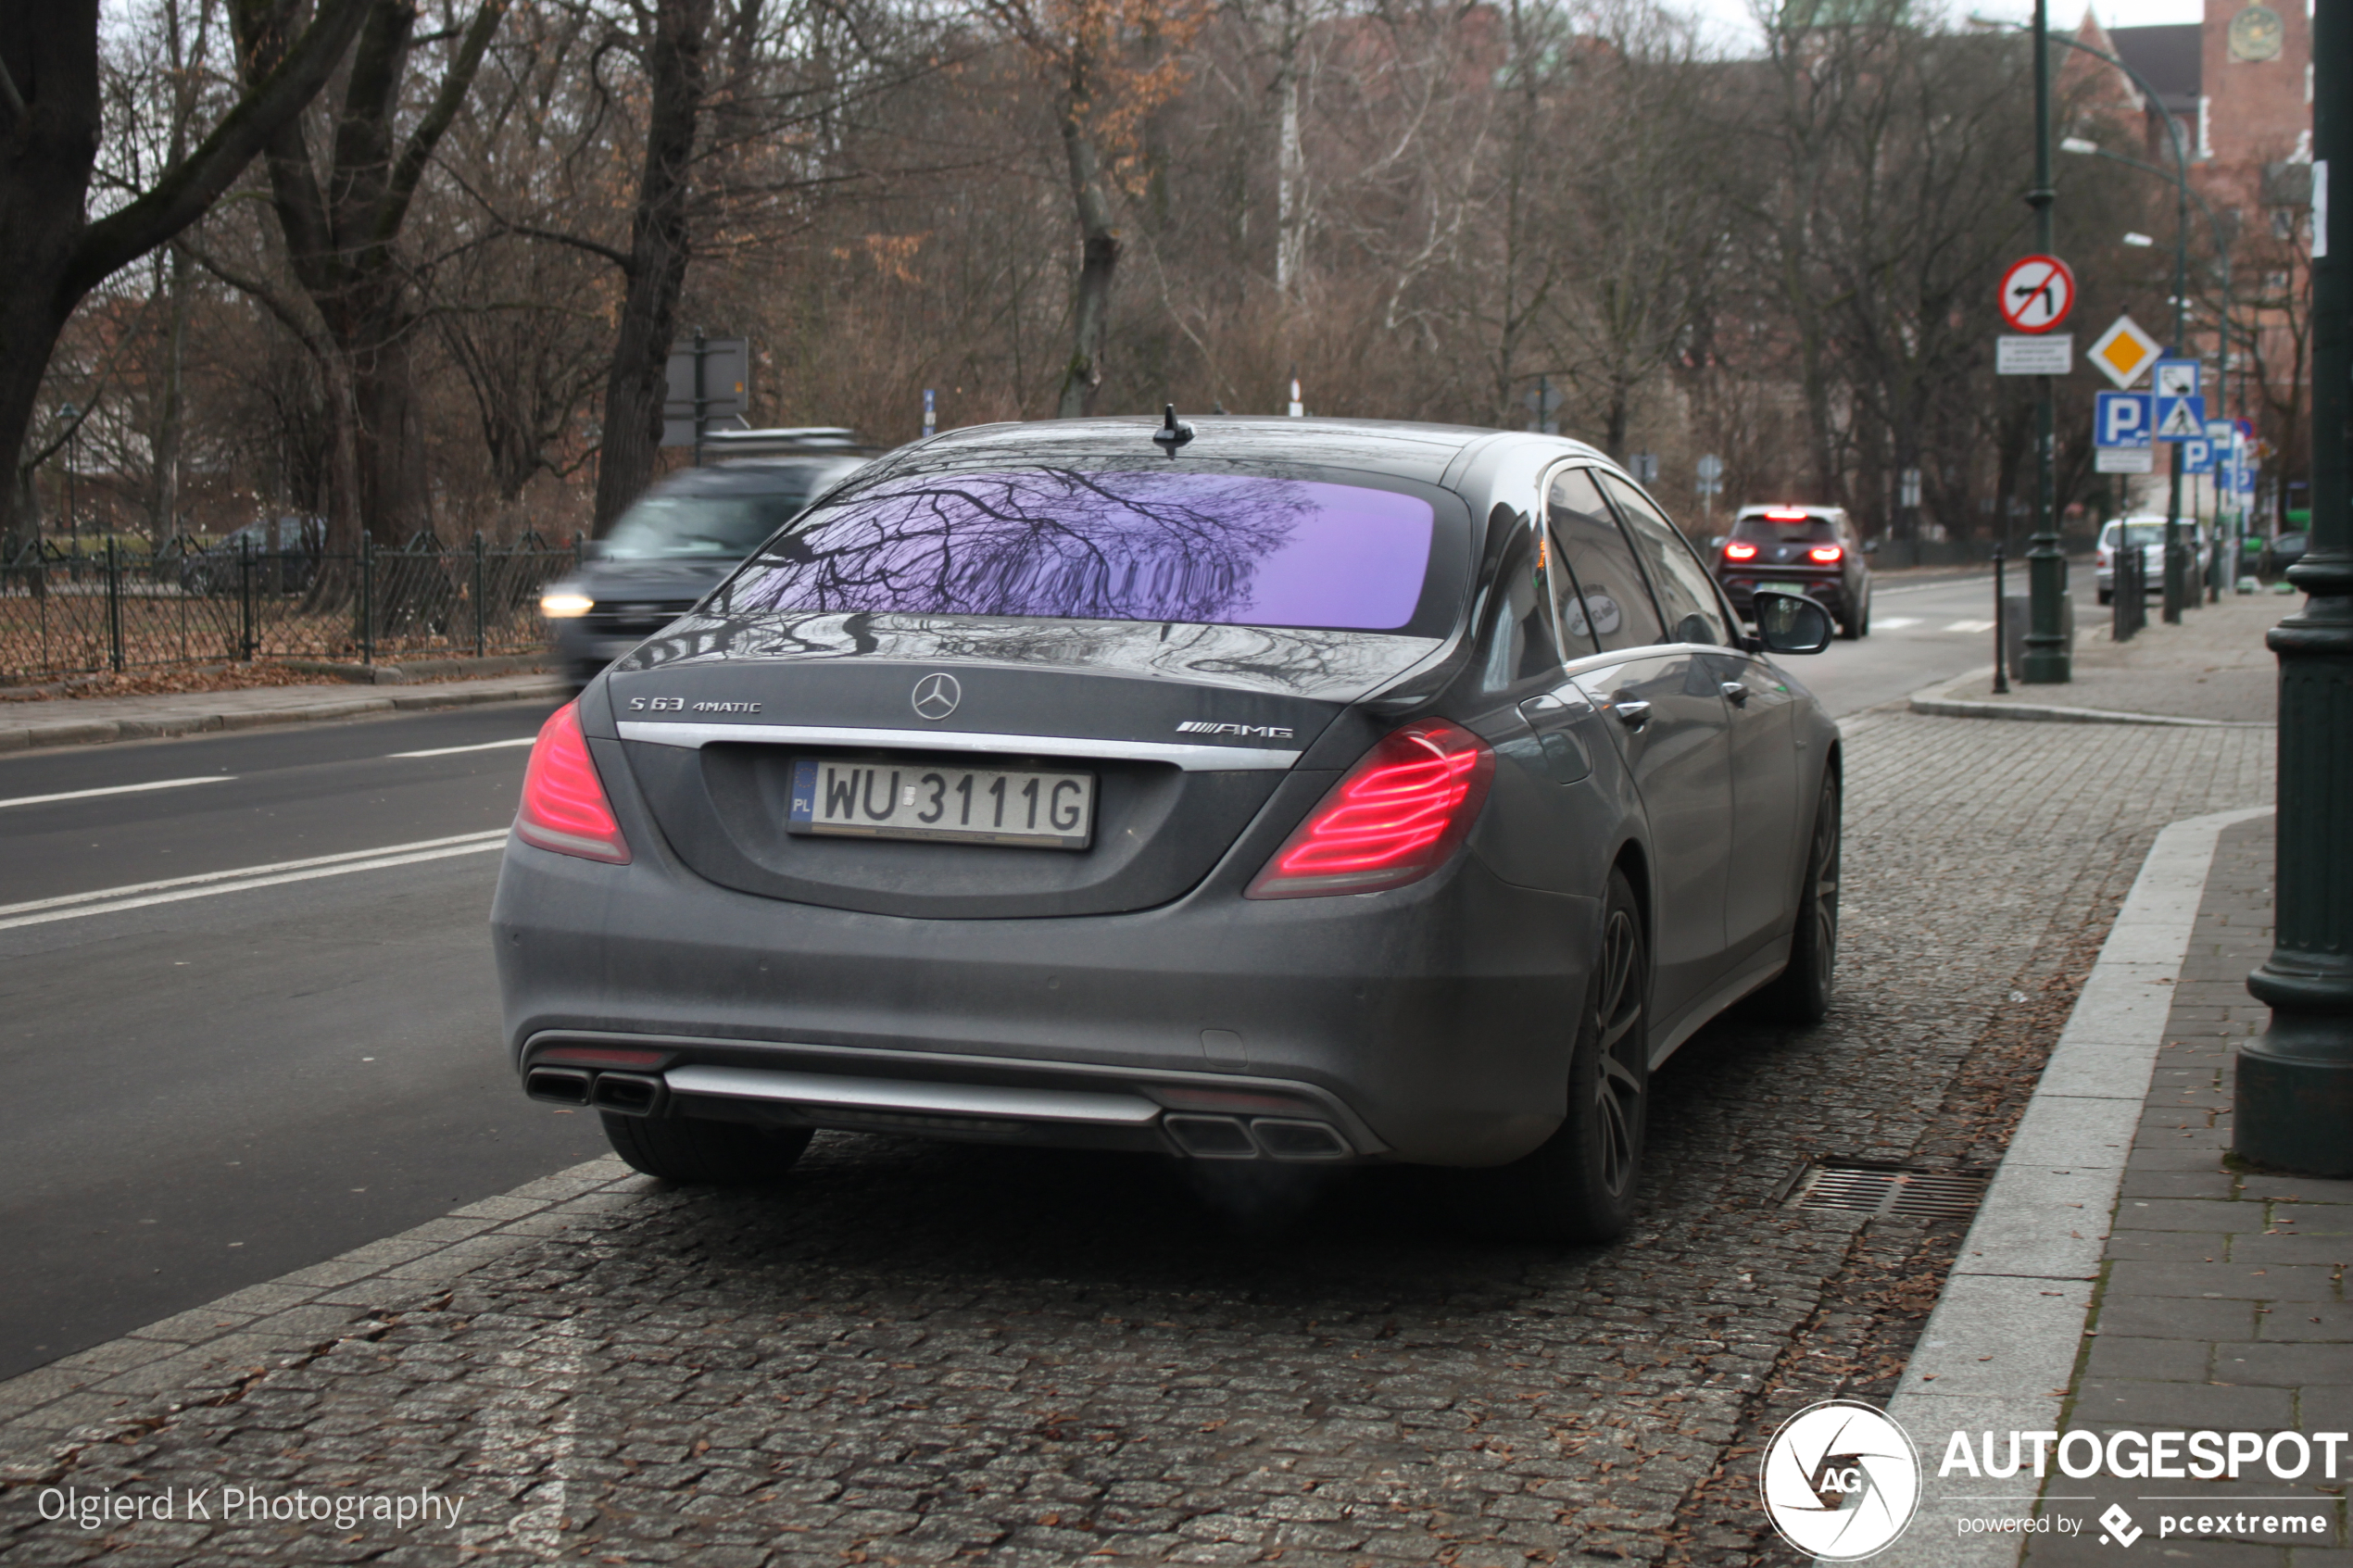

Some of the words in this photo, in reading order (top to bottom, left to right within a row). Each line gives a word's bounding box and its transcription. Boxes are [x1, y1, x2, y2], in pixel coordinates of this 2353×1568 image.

[2105, 397, 2142, 443] P
[2185, 441, 2208, 470] P
[628, 696, 647, 711] S
[650, 696, 686, 712] 63
[692, 701, 761, 713] 4MATIC
[1213, 723, 1293, 739] AMG
[792, 798, 811, 812] PL
[824, 768, 900, 822] WU
[916, 772, 1082, 832] 3111G
